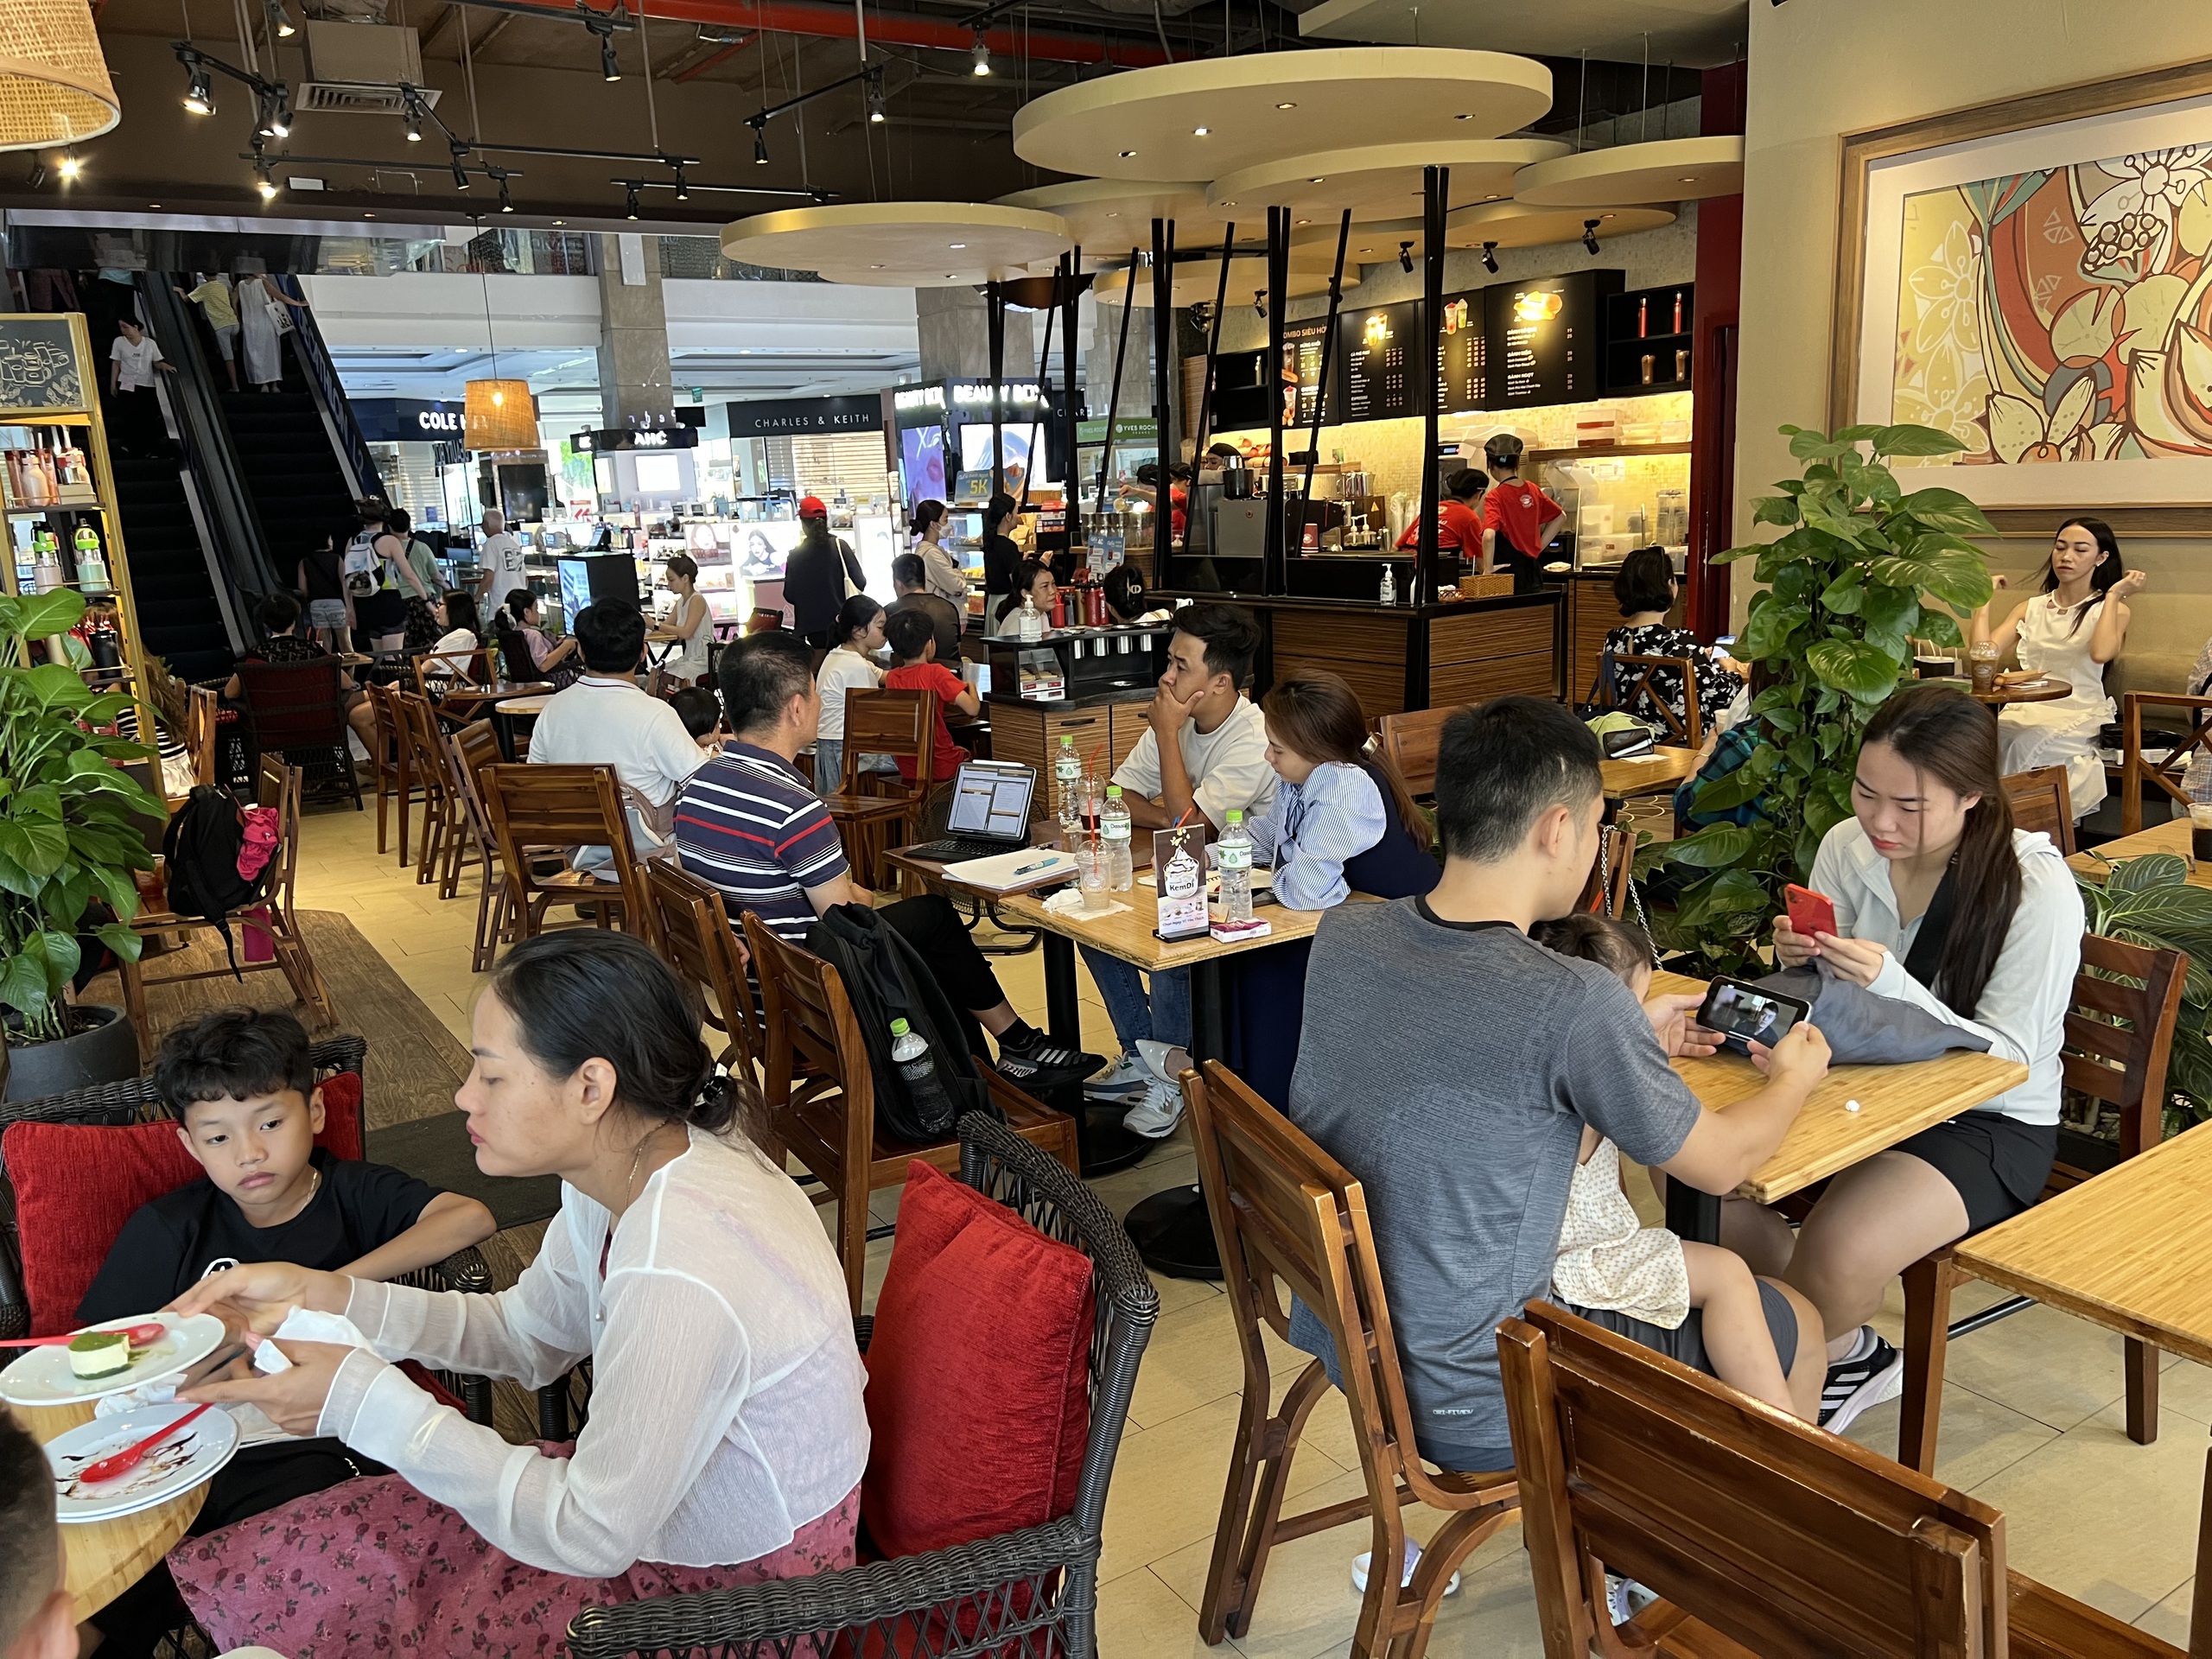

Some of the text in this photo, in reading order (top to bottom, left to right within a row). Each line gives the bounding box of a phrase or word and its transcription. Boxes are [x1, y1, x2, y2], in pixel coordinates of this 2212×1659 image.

[1283, 330, 1301, 339] OMBO
[953, 385, 1009, 403] BEAUY
[419, 411, 458, 430] COLE
[754, 414, 869, 428] CHARLES & KEITH
[969, 479, 988, 494] 5K
